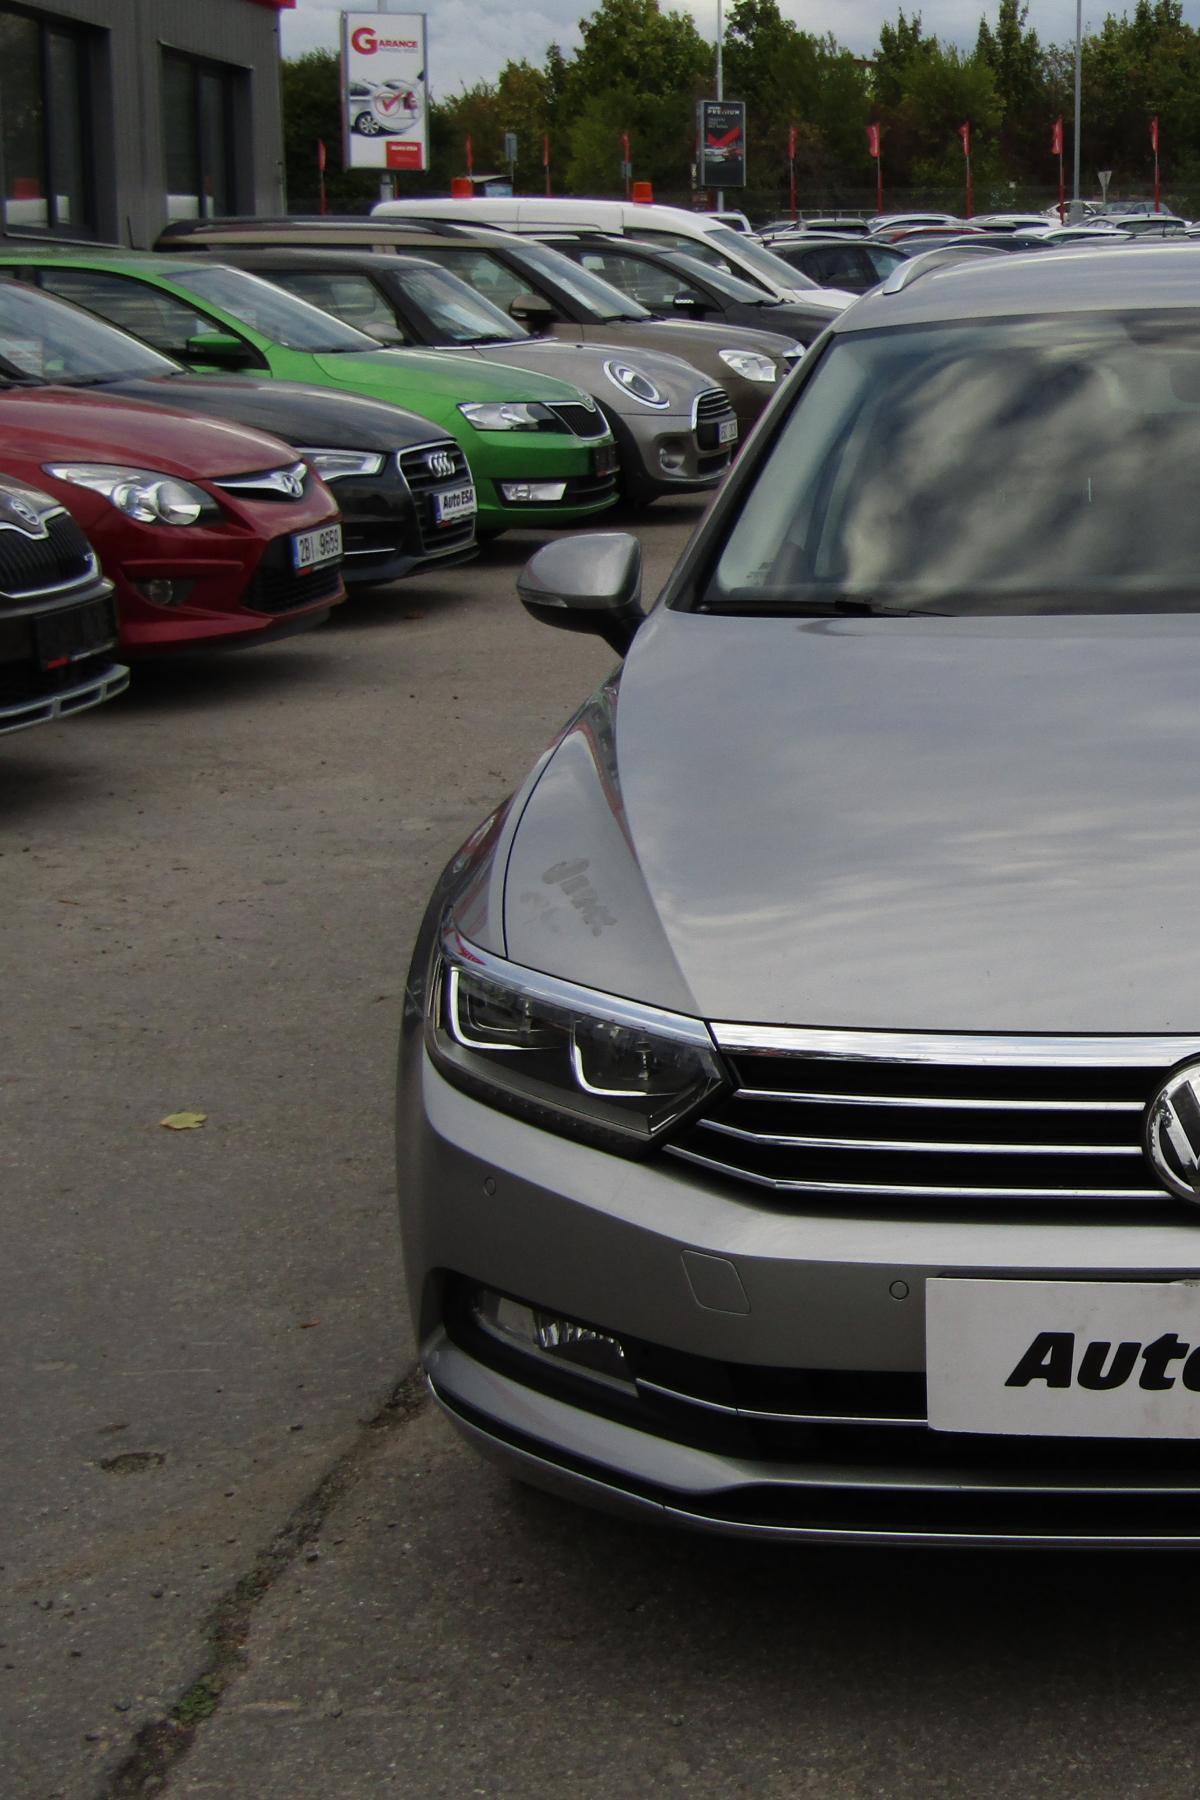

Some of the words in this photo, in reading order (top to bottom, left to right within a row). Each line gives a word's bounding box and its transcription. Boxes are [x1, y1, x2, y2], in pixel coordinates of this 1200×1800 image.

[351, 26, 418, 56] GARANCE
[443, 493, 461, 510] Auto
[461, 489, 474, 505] ESA
